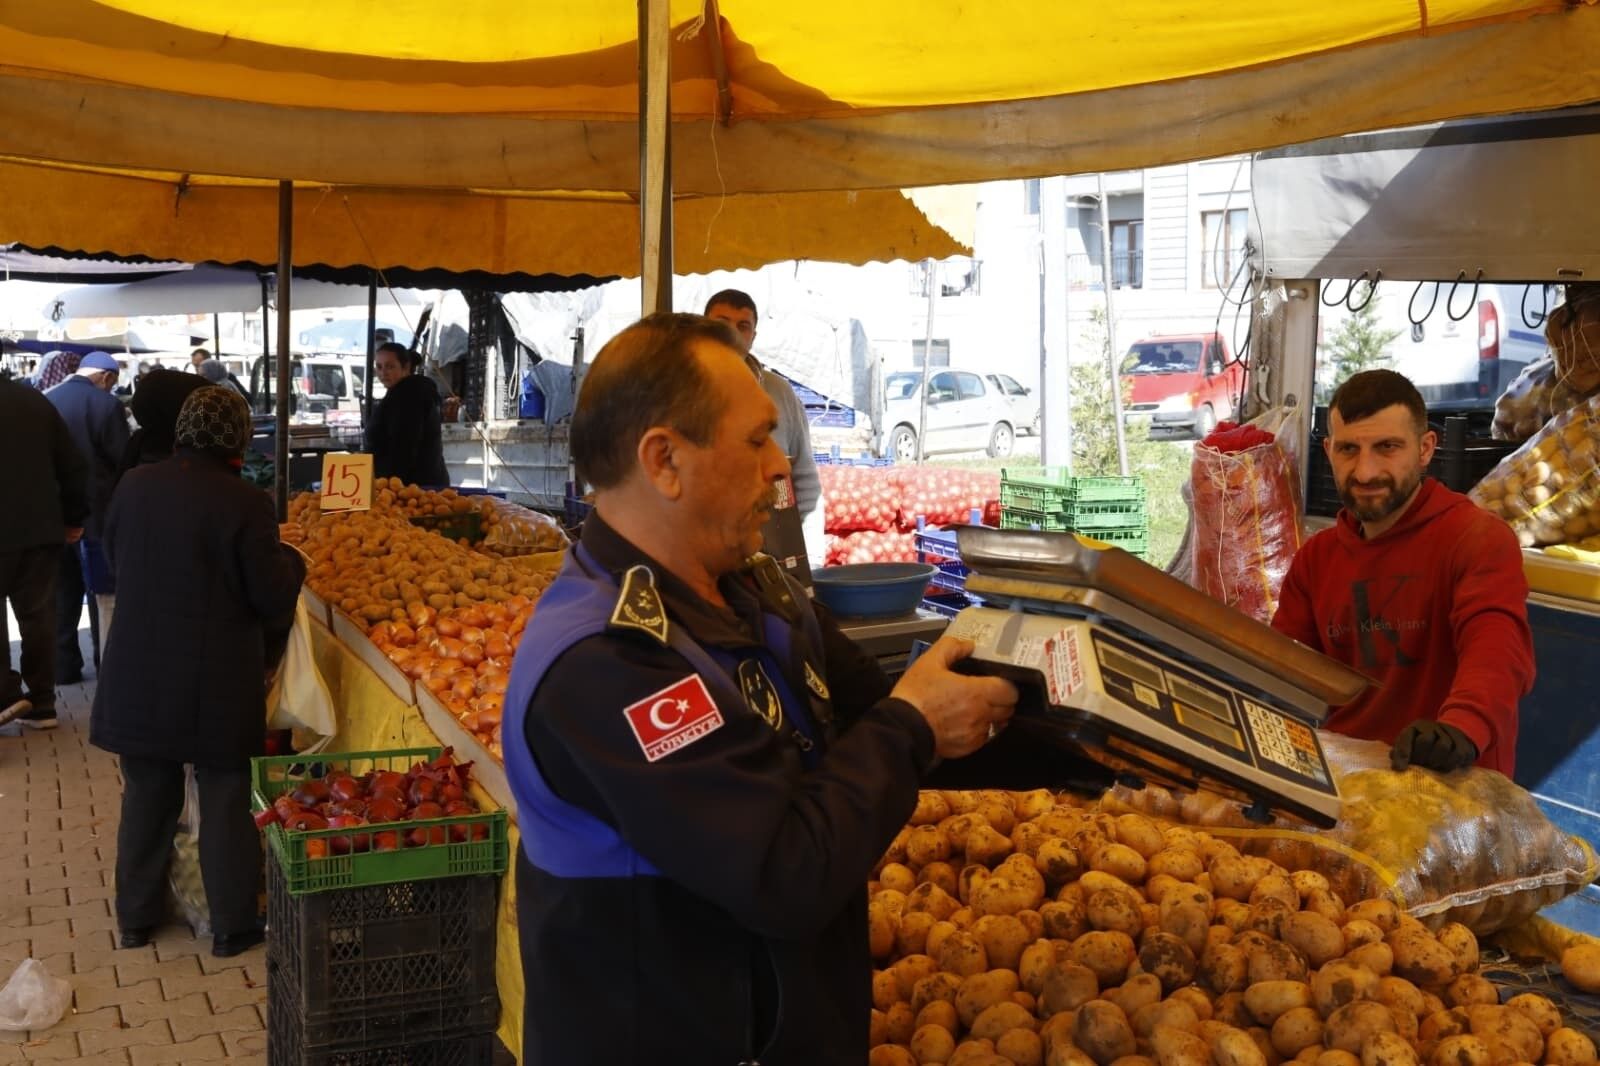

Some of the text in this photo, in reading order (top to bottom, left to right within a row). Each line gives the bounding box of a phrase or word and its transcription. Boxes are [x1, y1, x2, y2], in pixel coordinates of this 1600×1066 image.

[322, 463, 366, 498] 15
[1360, 616, 1392, 633] Klein
[1261, 710, 1269, 720] 8
[1253, 719, 1260, 728] 4
[1266, 724, 1274, 734] 5
[1280, 731, 1288, 740] 6
[1272, 740, 1280, 750] 2
[1285, 744, 1293, 755] 3
